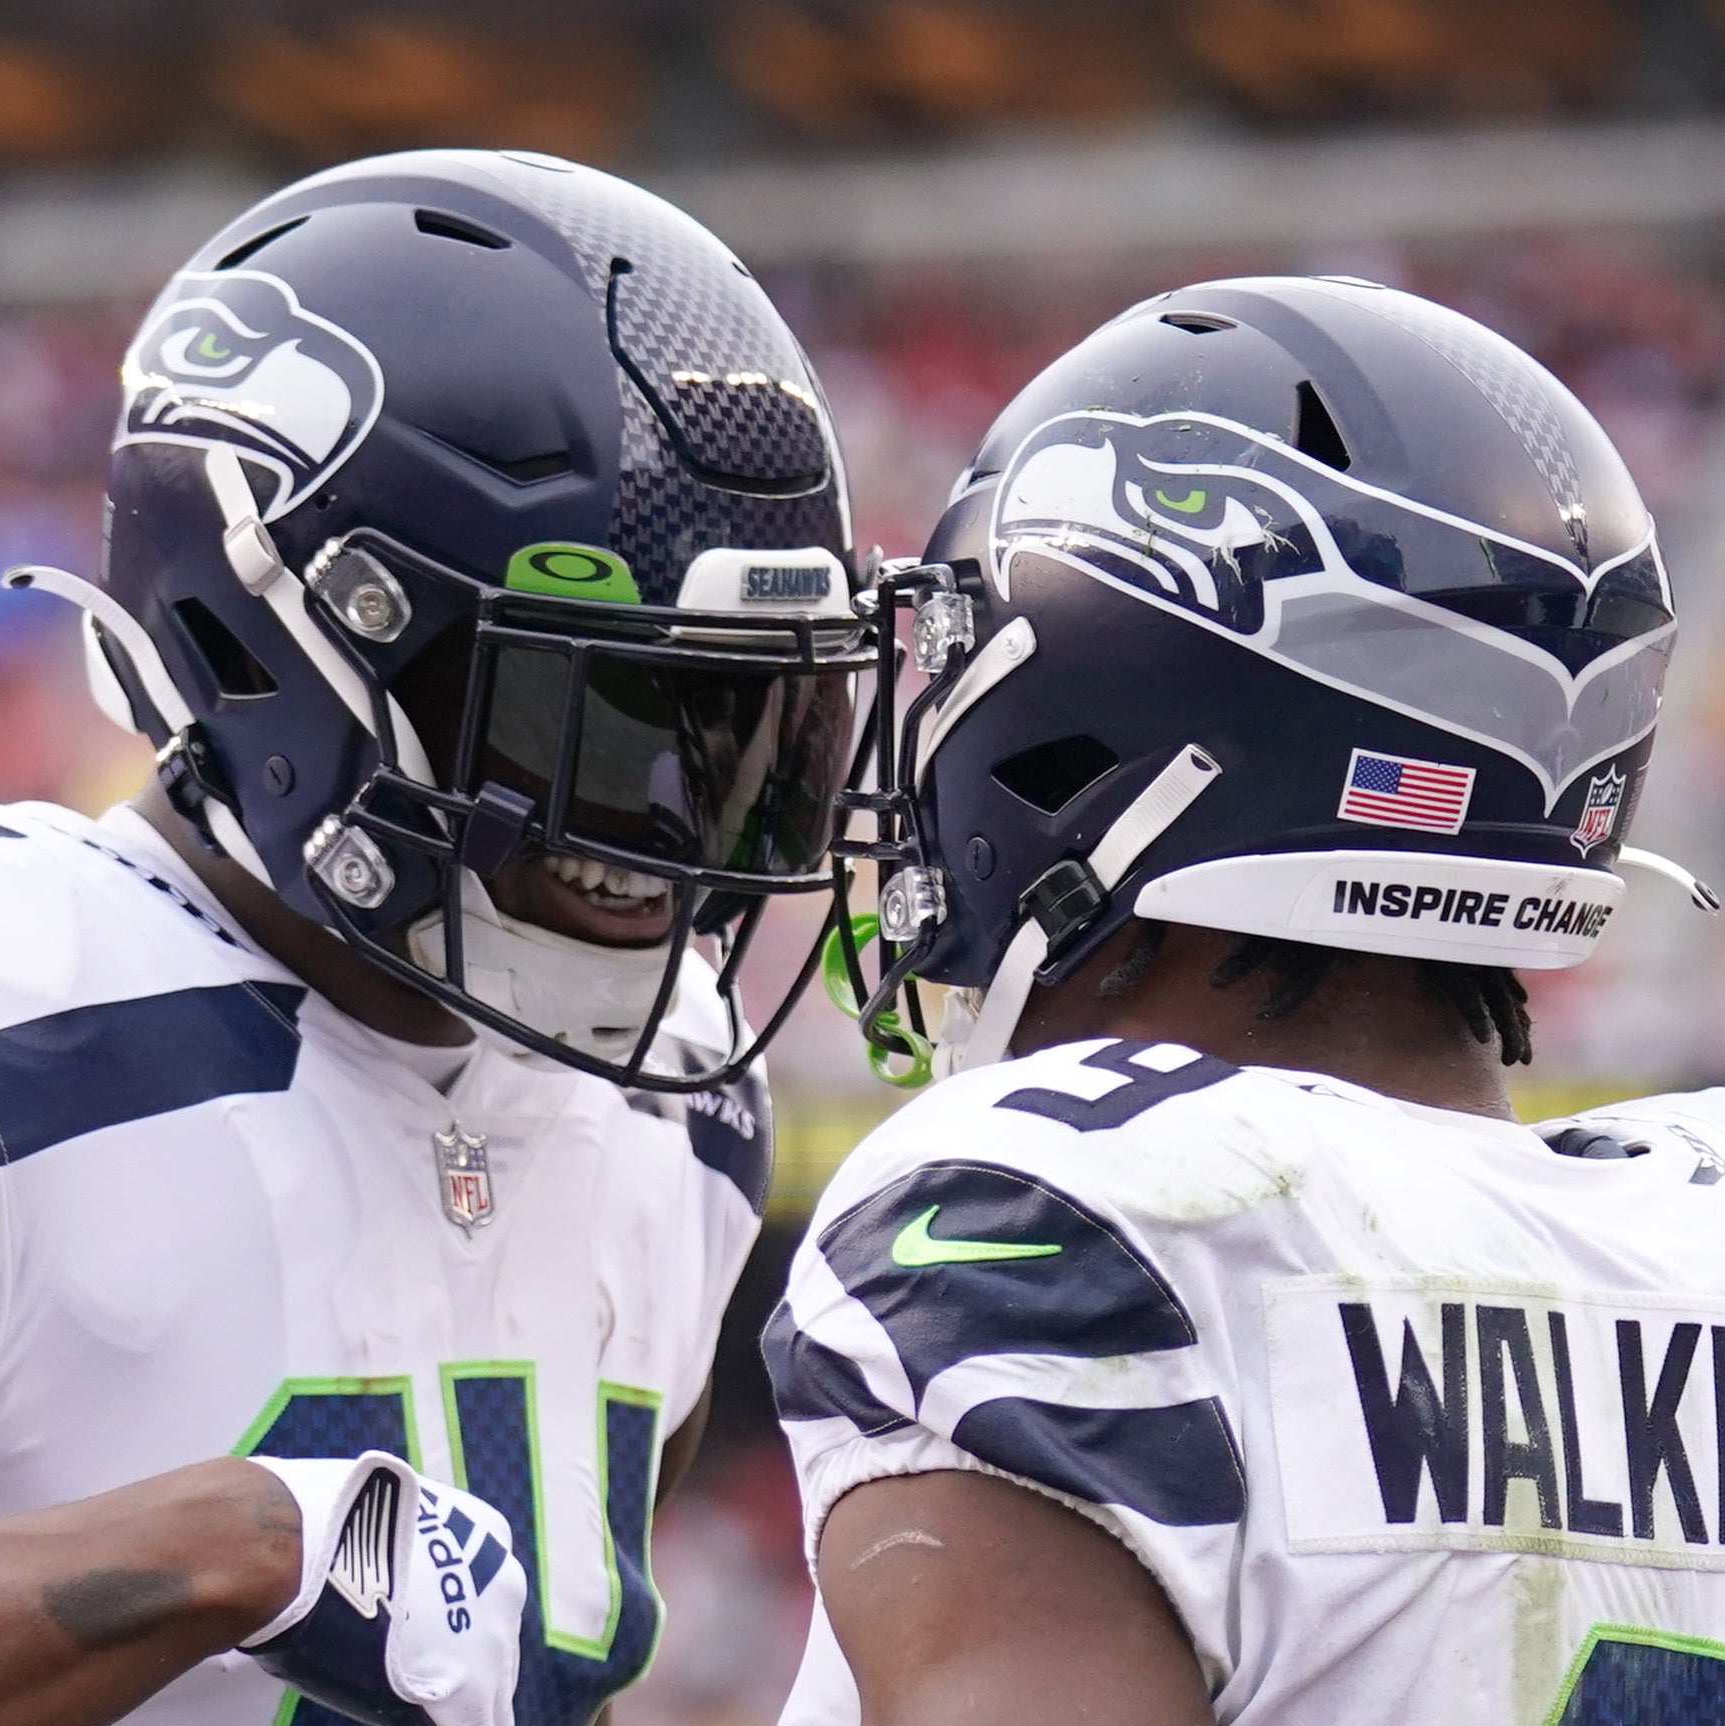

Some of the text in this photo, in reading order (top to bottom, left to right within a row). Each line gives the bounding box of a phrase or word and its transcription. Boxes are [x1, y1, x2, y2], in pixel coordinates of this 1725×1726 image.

[1583, 807, 1612, 843] NFL
[1333, 880, 1613, 938] INSPIRE CHANGE
[450, 1175, 488, 1215] NFL
